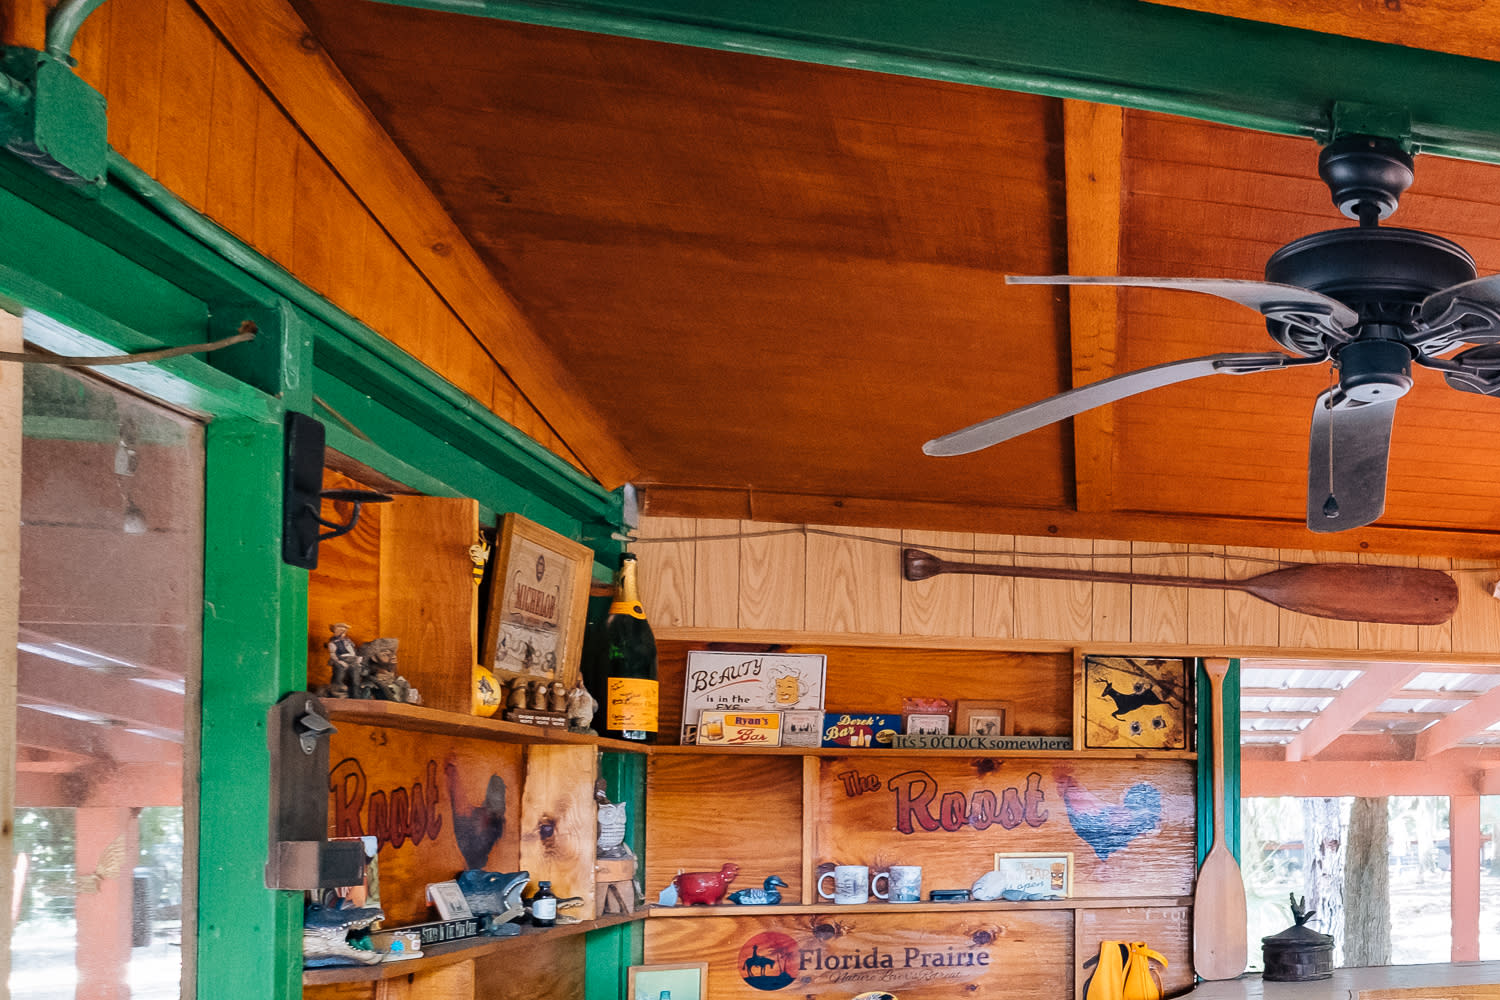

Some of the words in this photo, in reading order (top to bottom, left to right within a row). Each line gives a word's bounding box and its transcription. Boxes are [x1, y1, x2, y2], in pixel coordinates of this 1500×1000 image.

[691, 657, 764, 693] BEAUTY
[706, 695, 714, 703] is
[718, 695, 728, 703] in
[732, 694, 751, 704] the
[735, 716, 769, 727] Ryan's
[837, 714, 885, 726] Derek's
[729, 728, 769, 743] Bar
[823, 726, 856, 741] Bar
[897, 736, 916, 749] It's
[919, 736, 927, 749] 5
[930, 736, 989, 749] O'CLOCK
[990, 737, 1070, 750] somewhere
[328, 757, 443, 854] Roost
[838, 770, 882, 797] The
[888, 770, 1049, 834] Roost
[798, 947, 894, 971] Florida
[904, 946, 990, 968] Prairie
